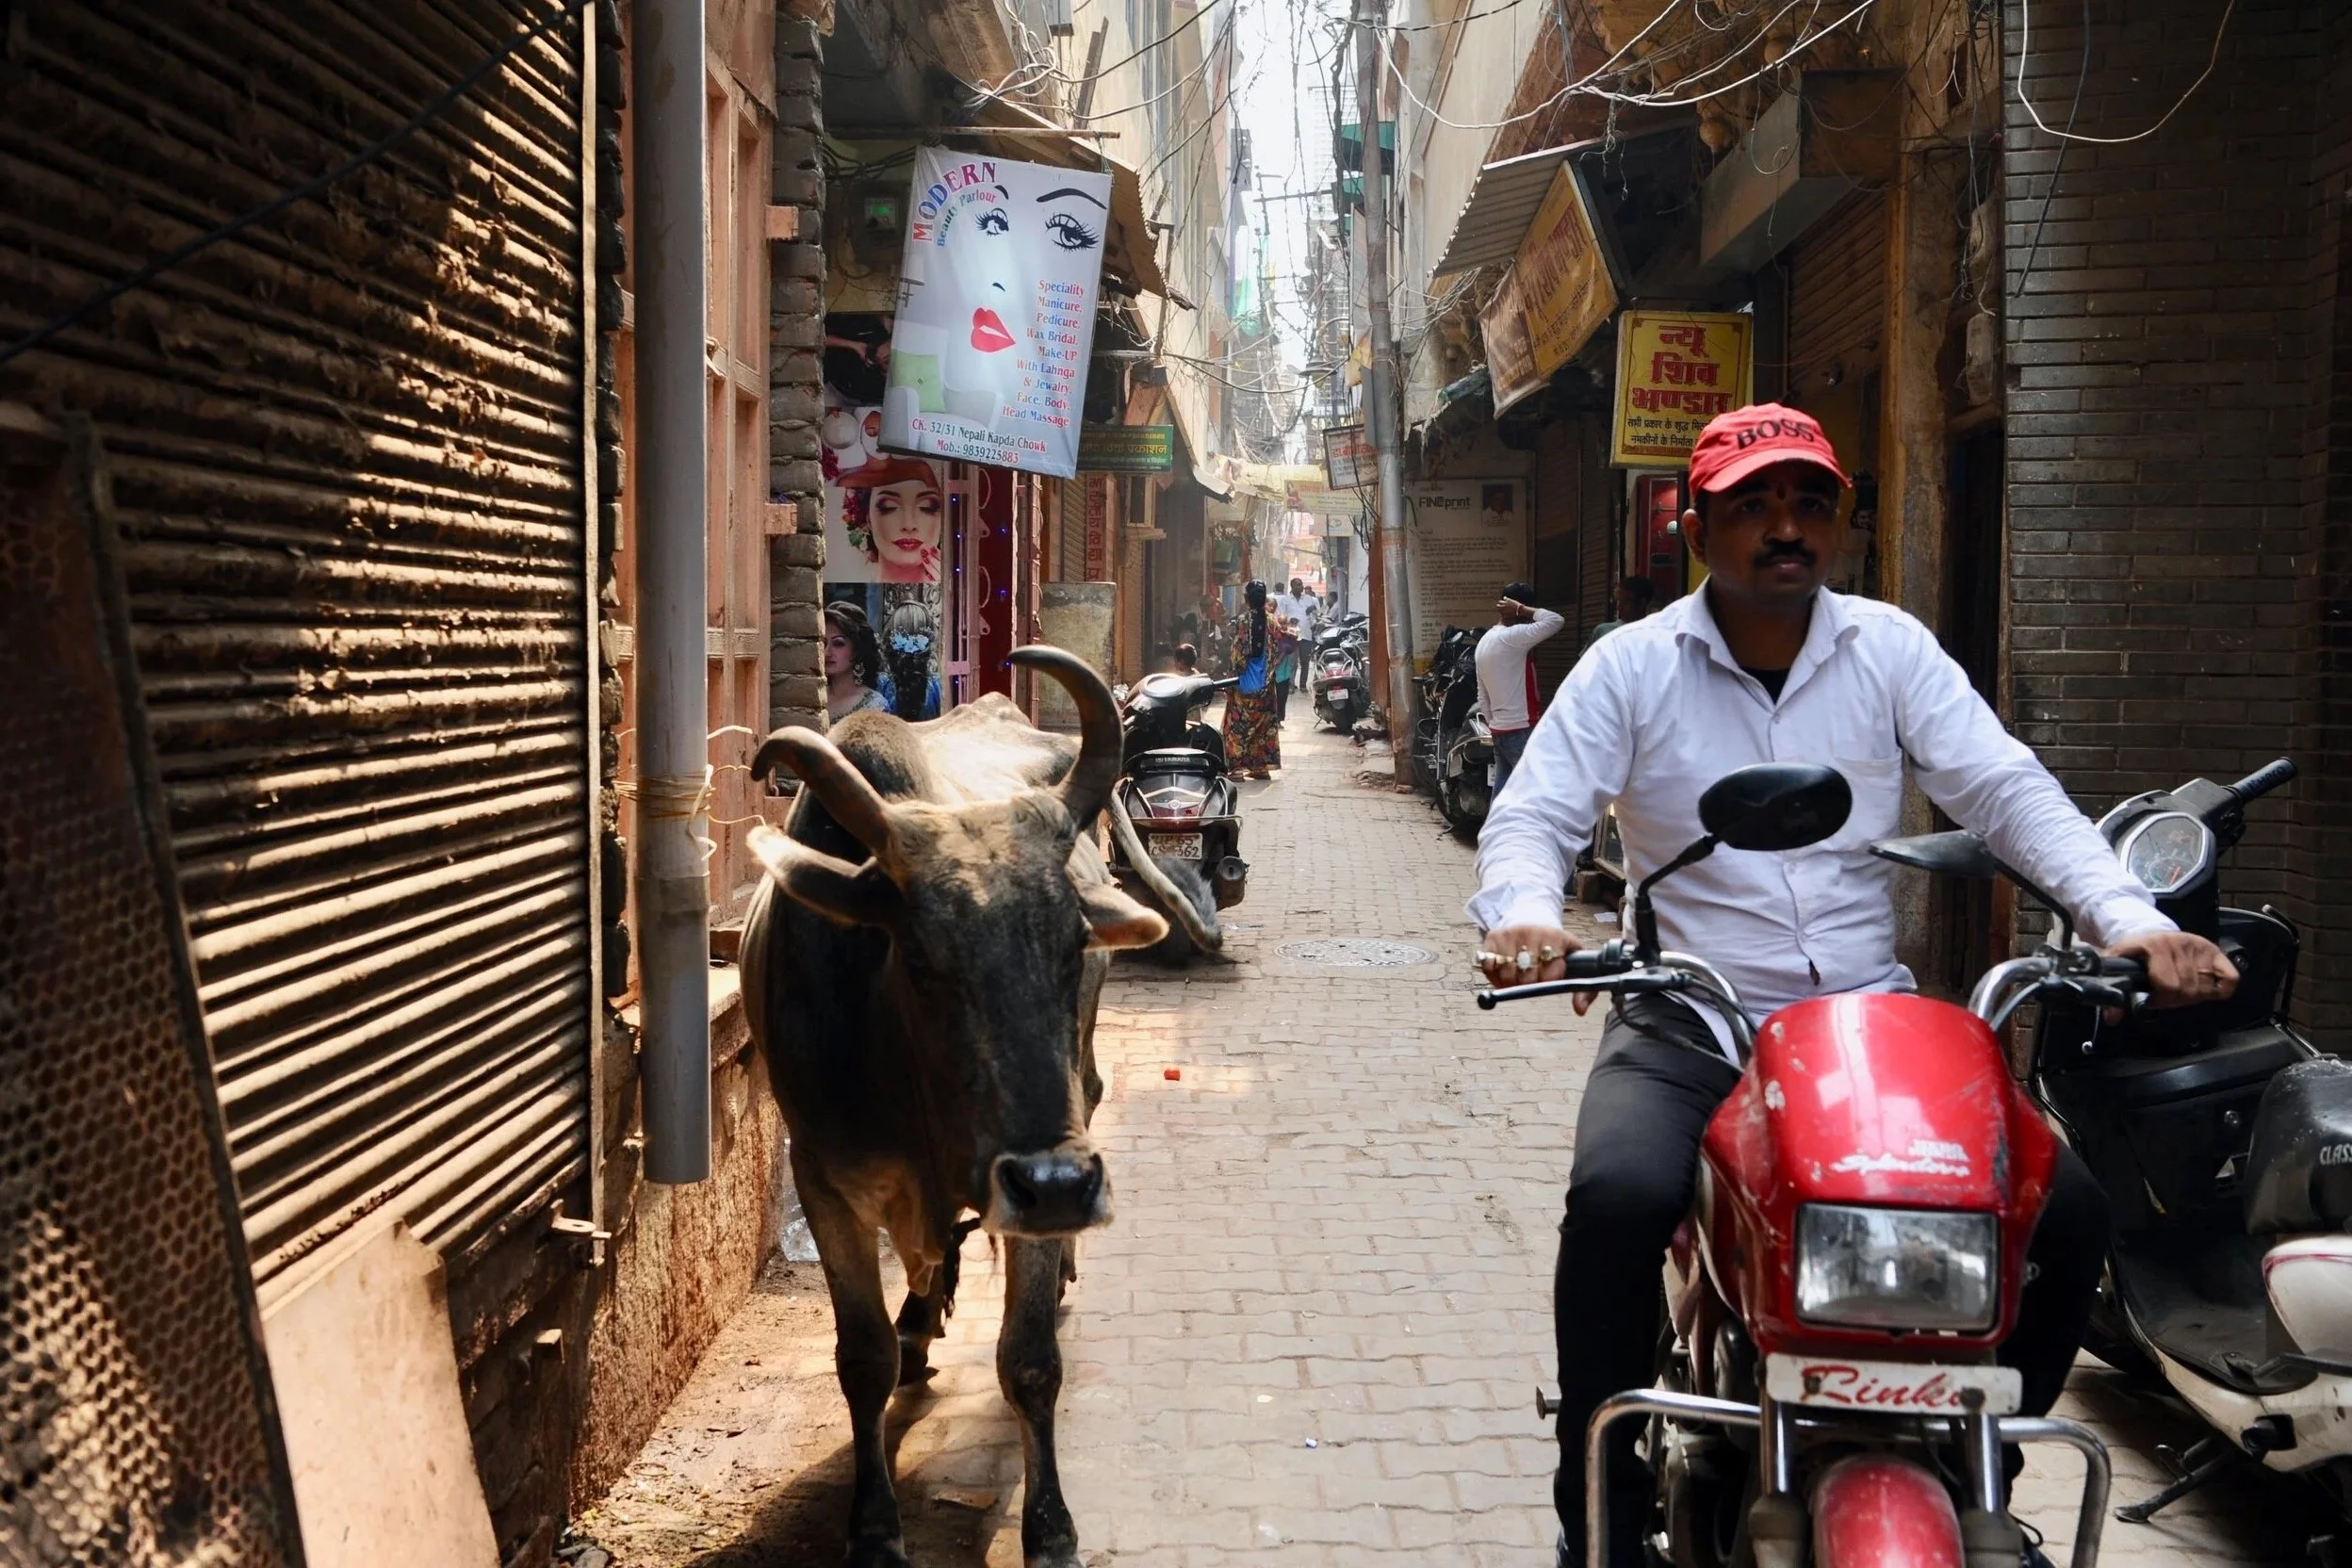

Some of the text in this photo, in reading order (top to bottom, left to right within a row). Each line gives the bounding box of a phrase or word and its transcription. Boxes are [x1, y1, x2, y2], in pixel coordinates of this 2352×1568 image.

[913, 162, 996, 241] MODERN
[937, 188, 996, 247] Beauty Parlour
[1038, 279, 1085, 299] Speciality
[1037, 296, 1083, 313] Manicure,
[1026, 327, 1044, 340] Wax
[1658, 325, 1709, 357] न्यू
[1037, 346, 1077, 361] Make-UP
[1017, 359, 1075, 380] With Lahnga
[1651, 351, 1720, 387] शिव
[1023, 377, 1031, 386] &
[1632, 387, 1732, 415] भण्डार
[1003, 405, 1070, 428] Head Massage
[1643, 418, 1663, 429] प्रकार
[1665, 418, 1673, 429] के
[912, 418, 1046, 451] CK. 32/31 Nepali Kapda Chowk
[1660, 434, 1668, 446] के
[1737, 417, 1815, 449] BOSS
[963, 444, 1019, 464] 9839225883
